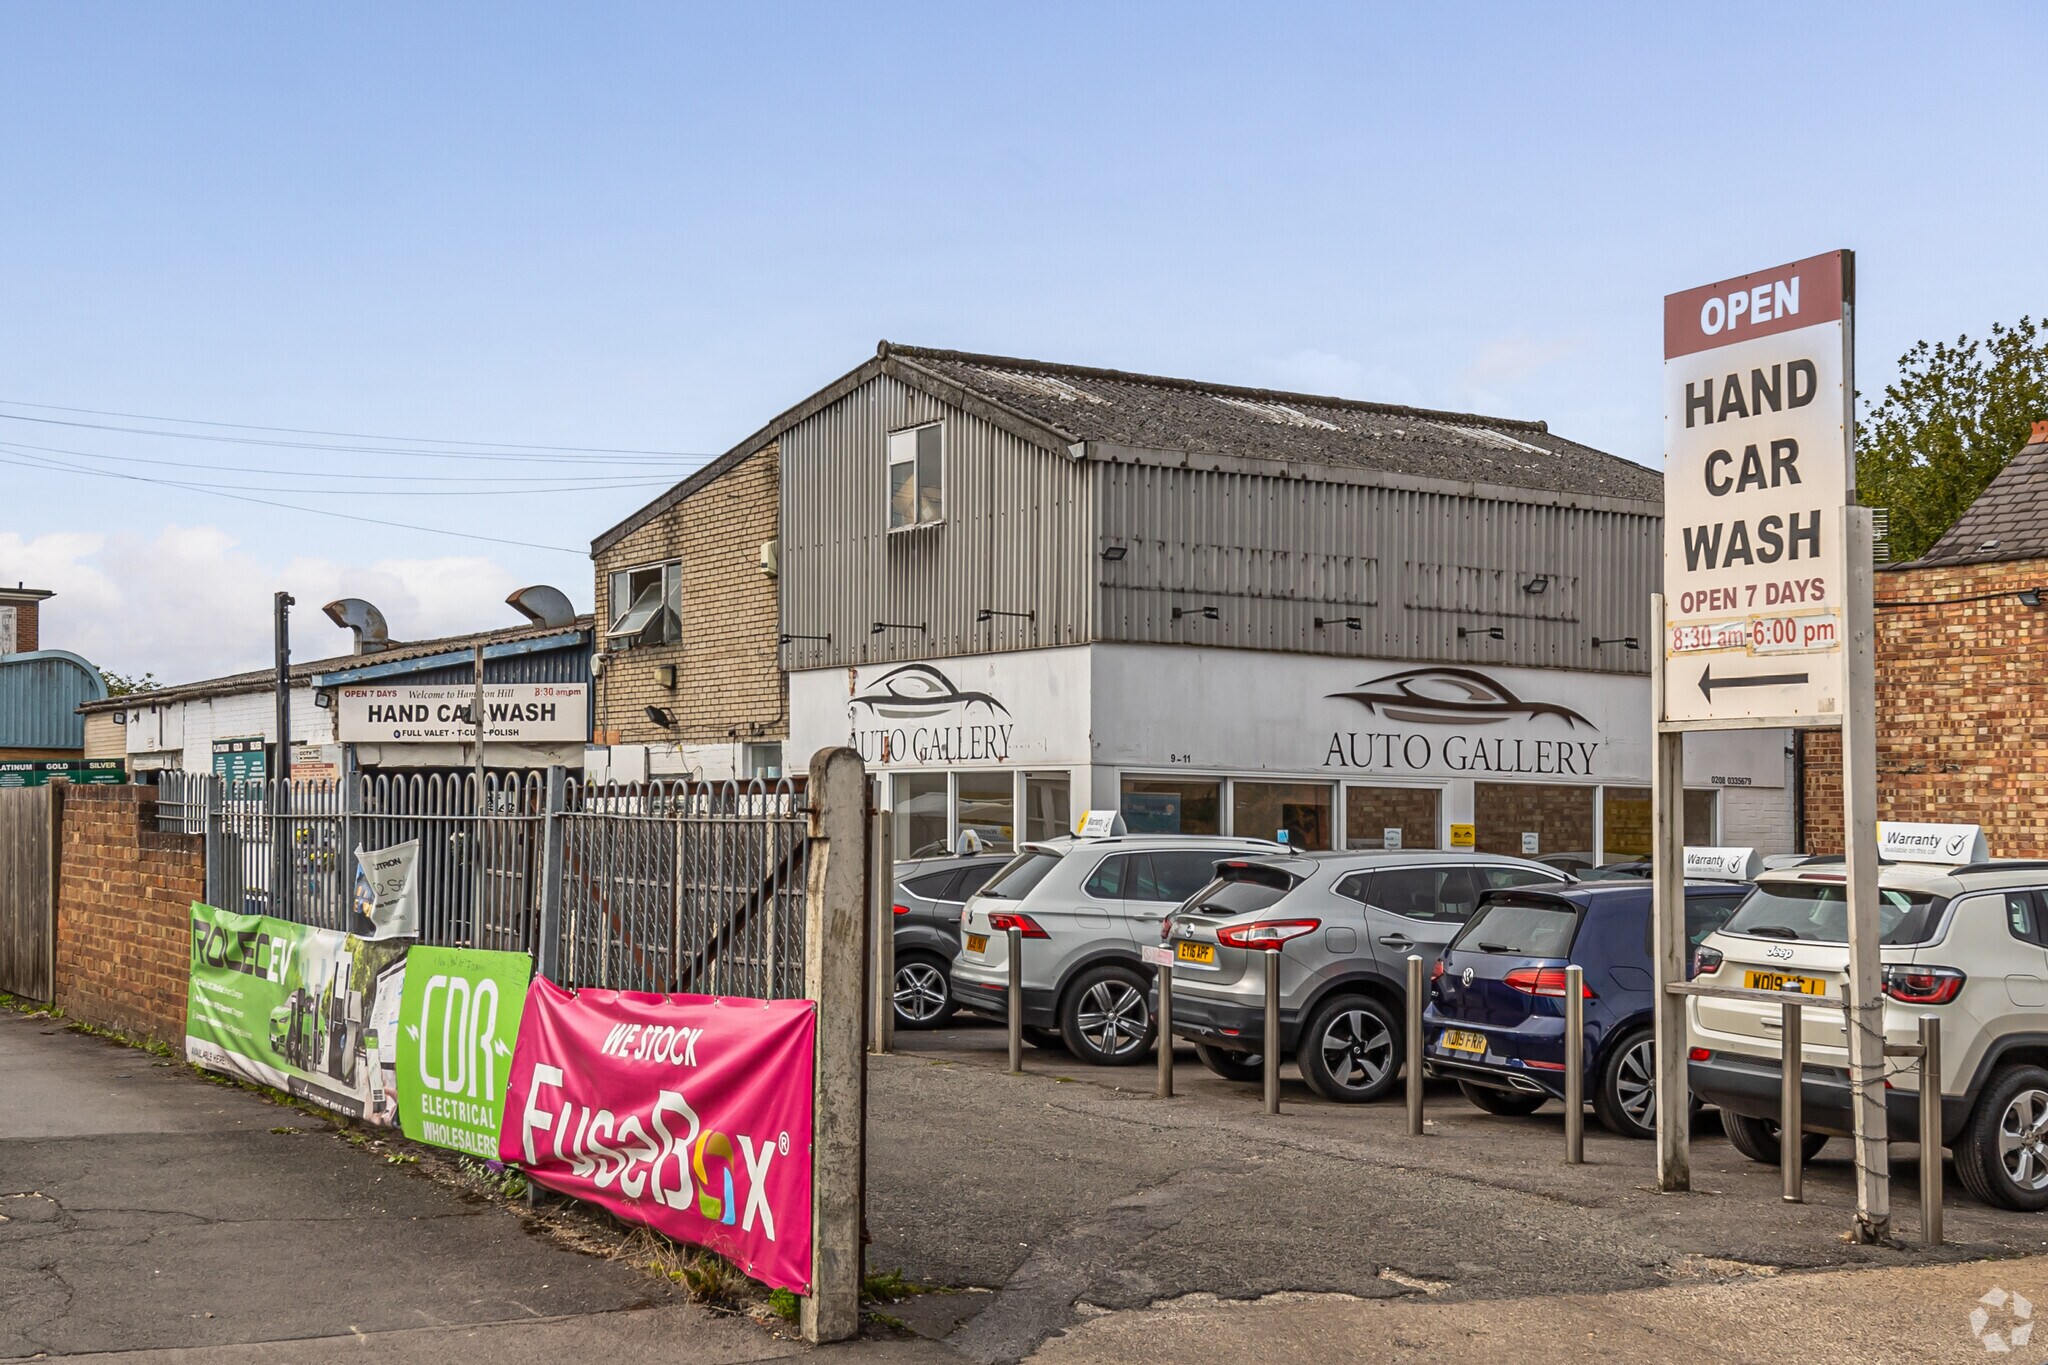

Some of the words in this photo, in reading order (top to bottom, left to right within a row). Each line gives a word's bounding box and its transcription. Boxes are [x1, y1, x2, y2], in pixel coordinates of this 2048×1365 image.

[1700, 276, 1800, 336] OPEN
[1685, 358, 1818, 429] HAND
[1704, 437, 1802, 497] CAR
[1682, 509, 1822, 572] WASH
[1680, 586, 1738, 614] OPEN
[1745, 584, 1758, 608] 7
[1765, 577, 1826, 606] DAYS
[1673, 625, 1712, 651] 8:30
[1804, 621, 1835, 647] pm
[344, 689, 369, 698] OPEN
[369, 689, 375, 698] 7
[376, 689, 398, 698] DAYS
[408, 690, 445, 699] Welcome
[446, 691, 455, 699] to
[456, 689, 495, 699] Hamon
[497, 688, 515, 698] Hill
[368, 703, 430, 723] HAND
[437, 703, 473, 723] CA
[488, 702, 557, 722] WASH
[402, 729, 423, 737] FULL
[424, 728, 450, 737] VALET
[456, 728, 477, 737] T-CU
[489, 728, 519, 737] POLISH
[912, 723, 1014, 763] GALLERY
[46, 762, 69, 770] GOLD
[89, 761, 117, 769] SILVER
[1322, 731, 1432, 770] AUTO
[1442, 735, 1600, 776] GALLERY
[1710, 775, 1726, 785] 0208
[1727, 776, 1752, 786] 0335679
[1886, 831, 1942, 849] Warranty
[372, 857, 402, 871] UTRON
[1686, 853, 1726, 868] Warranty
[1766, 945, 1794, 961] Jeep
[419, 974, 499, 1102] CDR
[600, 1022, 642, 1058] WE
[633, 1024, 704, 1068] STOCK
[421, 1093, 496, 1130] ELECTRICAL
[422, 1120, 498, 1159] WHOLESALERS
